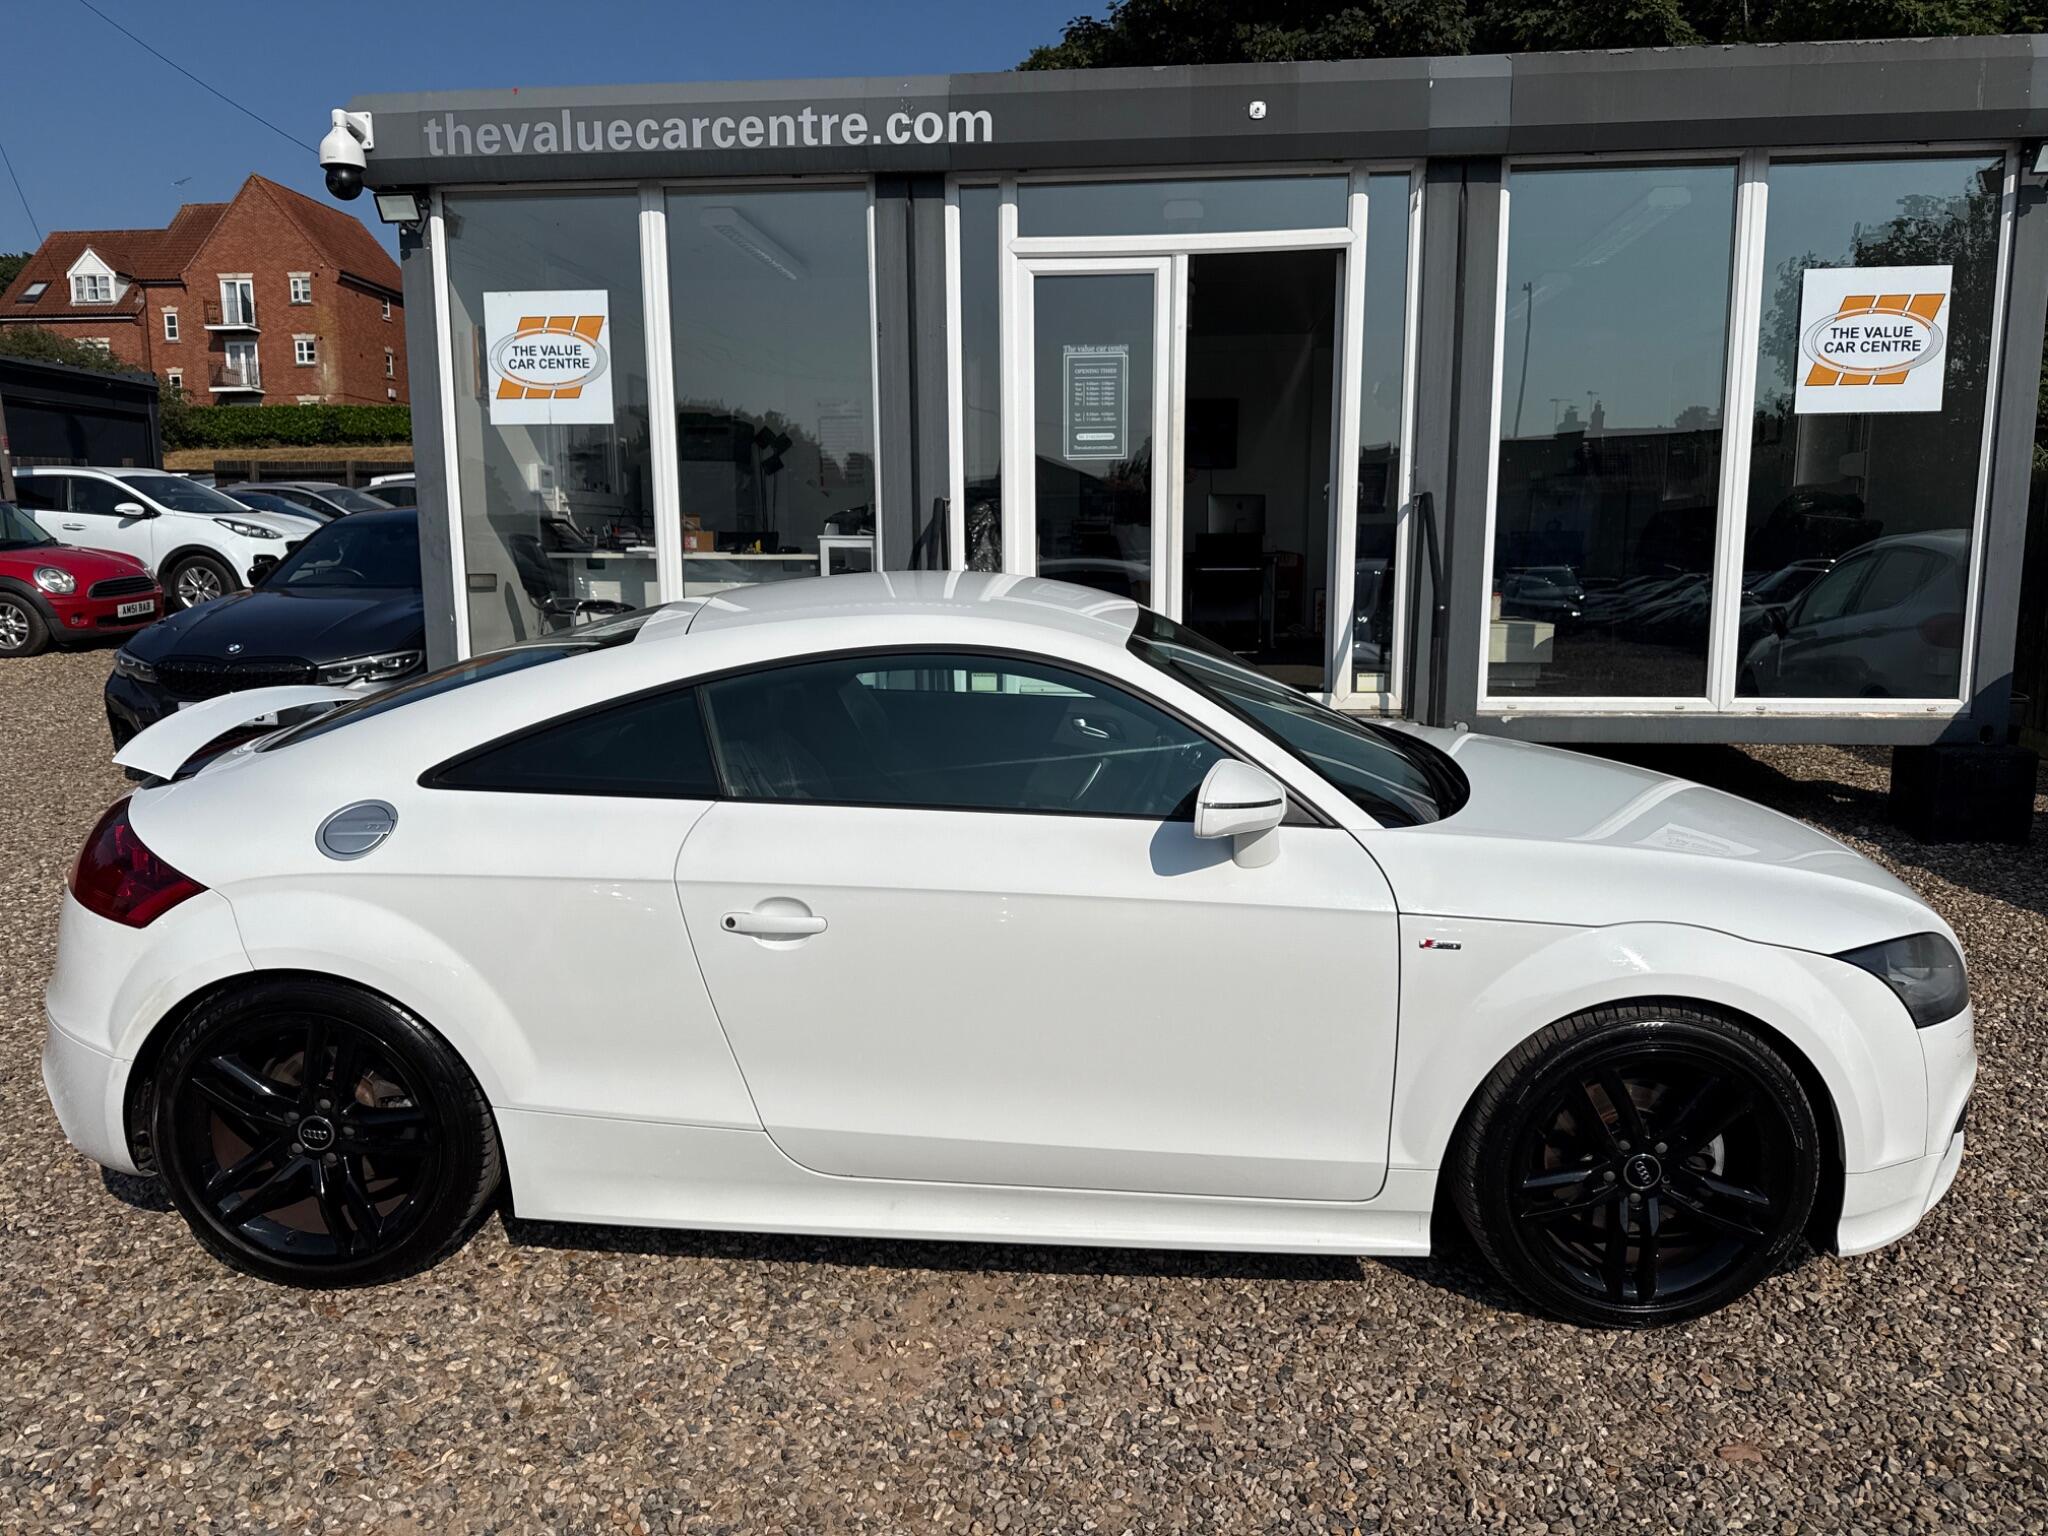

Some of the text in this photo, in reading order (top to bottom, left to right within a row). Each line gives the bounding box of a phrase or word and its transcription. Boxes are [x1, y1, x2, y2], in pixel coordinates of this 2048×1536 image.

[423, 106, 994, 156] thevaluecarcentre.com
[1830, 326, 1914, 340] THE VALUE
[512, 345, 582, 357] THE VALUE
[1824, 340, 1922, 354] CAR CENTRE
[508, 358, 591, 370] CAR CENTRE
